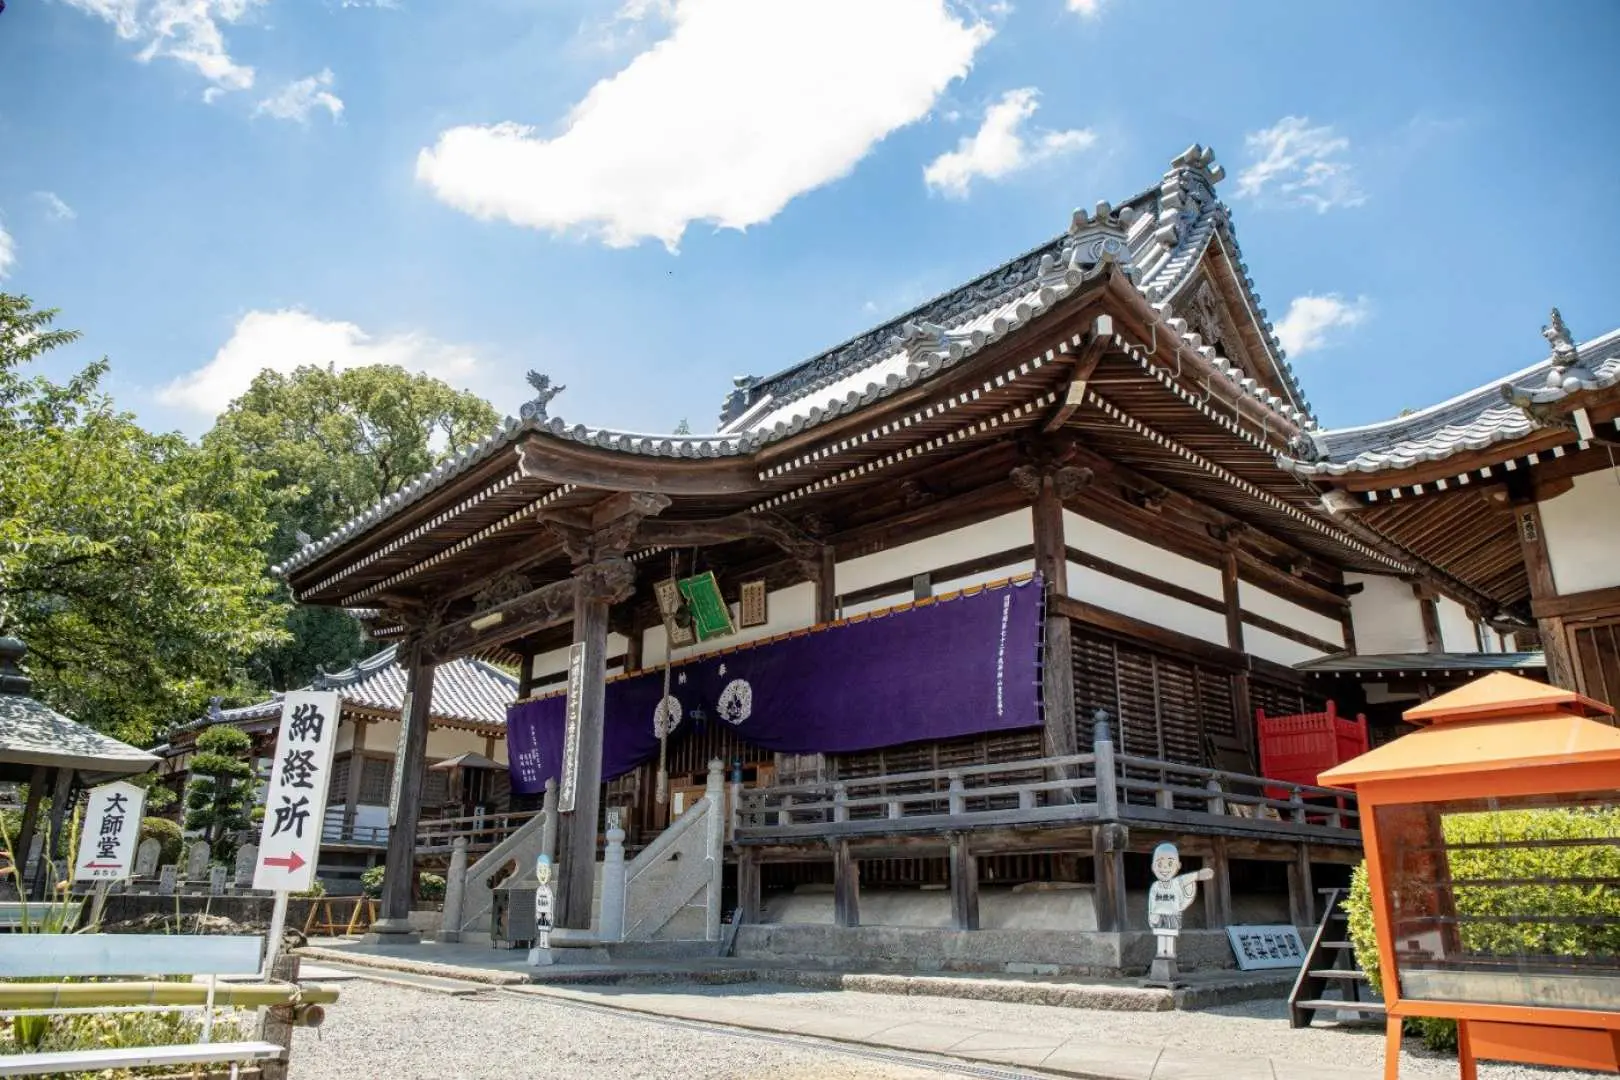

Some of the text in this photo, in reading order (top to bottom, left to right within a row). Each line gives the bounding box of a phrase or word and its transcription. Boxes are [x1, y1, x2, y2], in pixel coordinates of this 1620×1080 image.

[270, 703, 325, 838] 納経所
[96, 792, 128, 859] 大師堂
